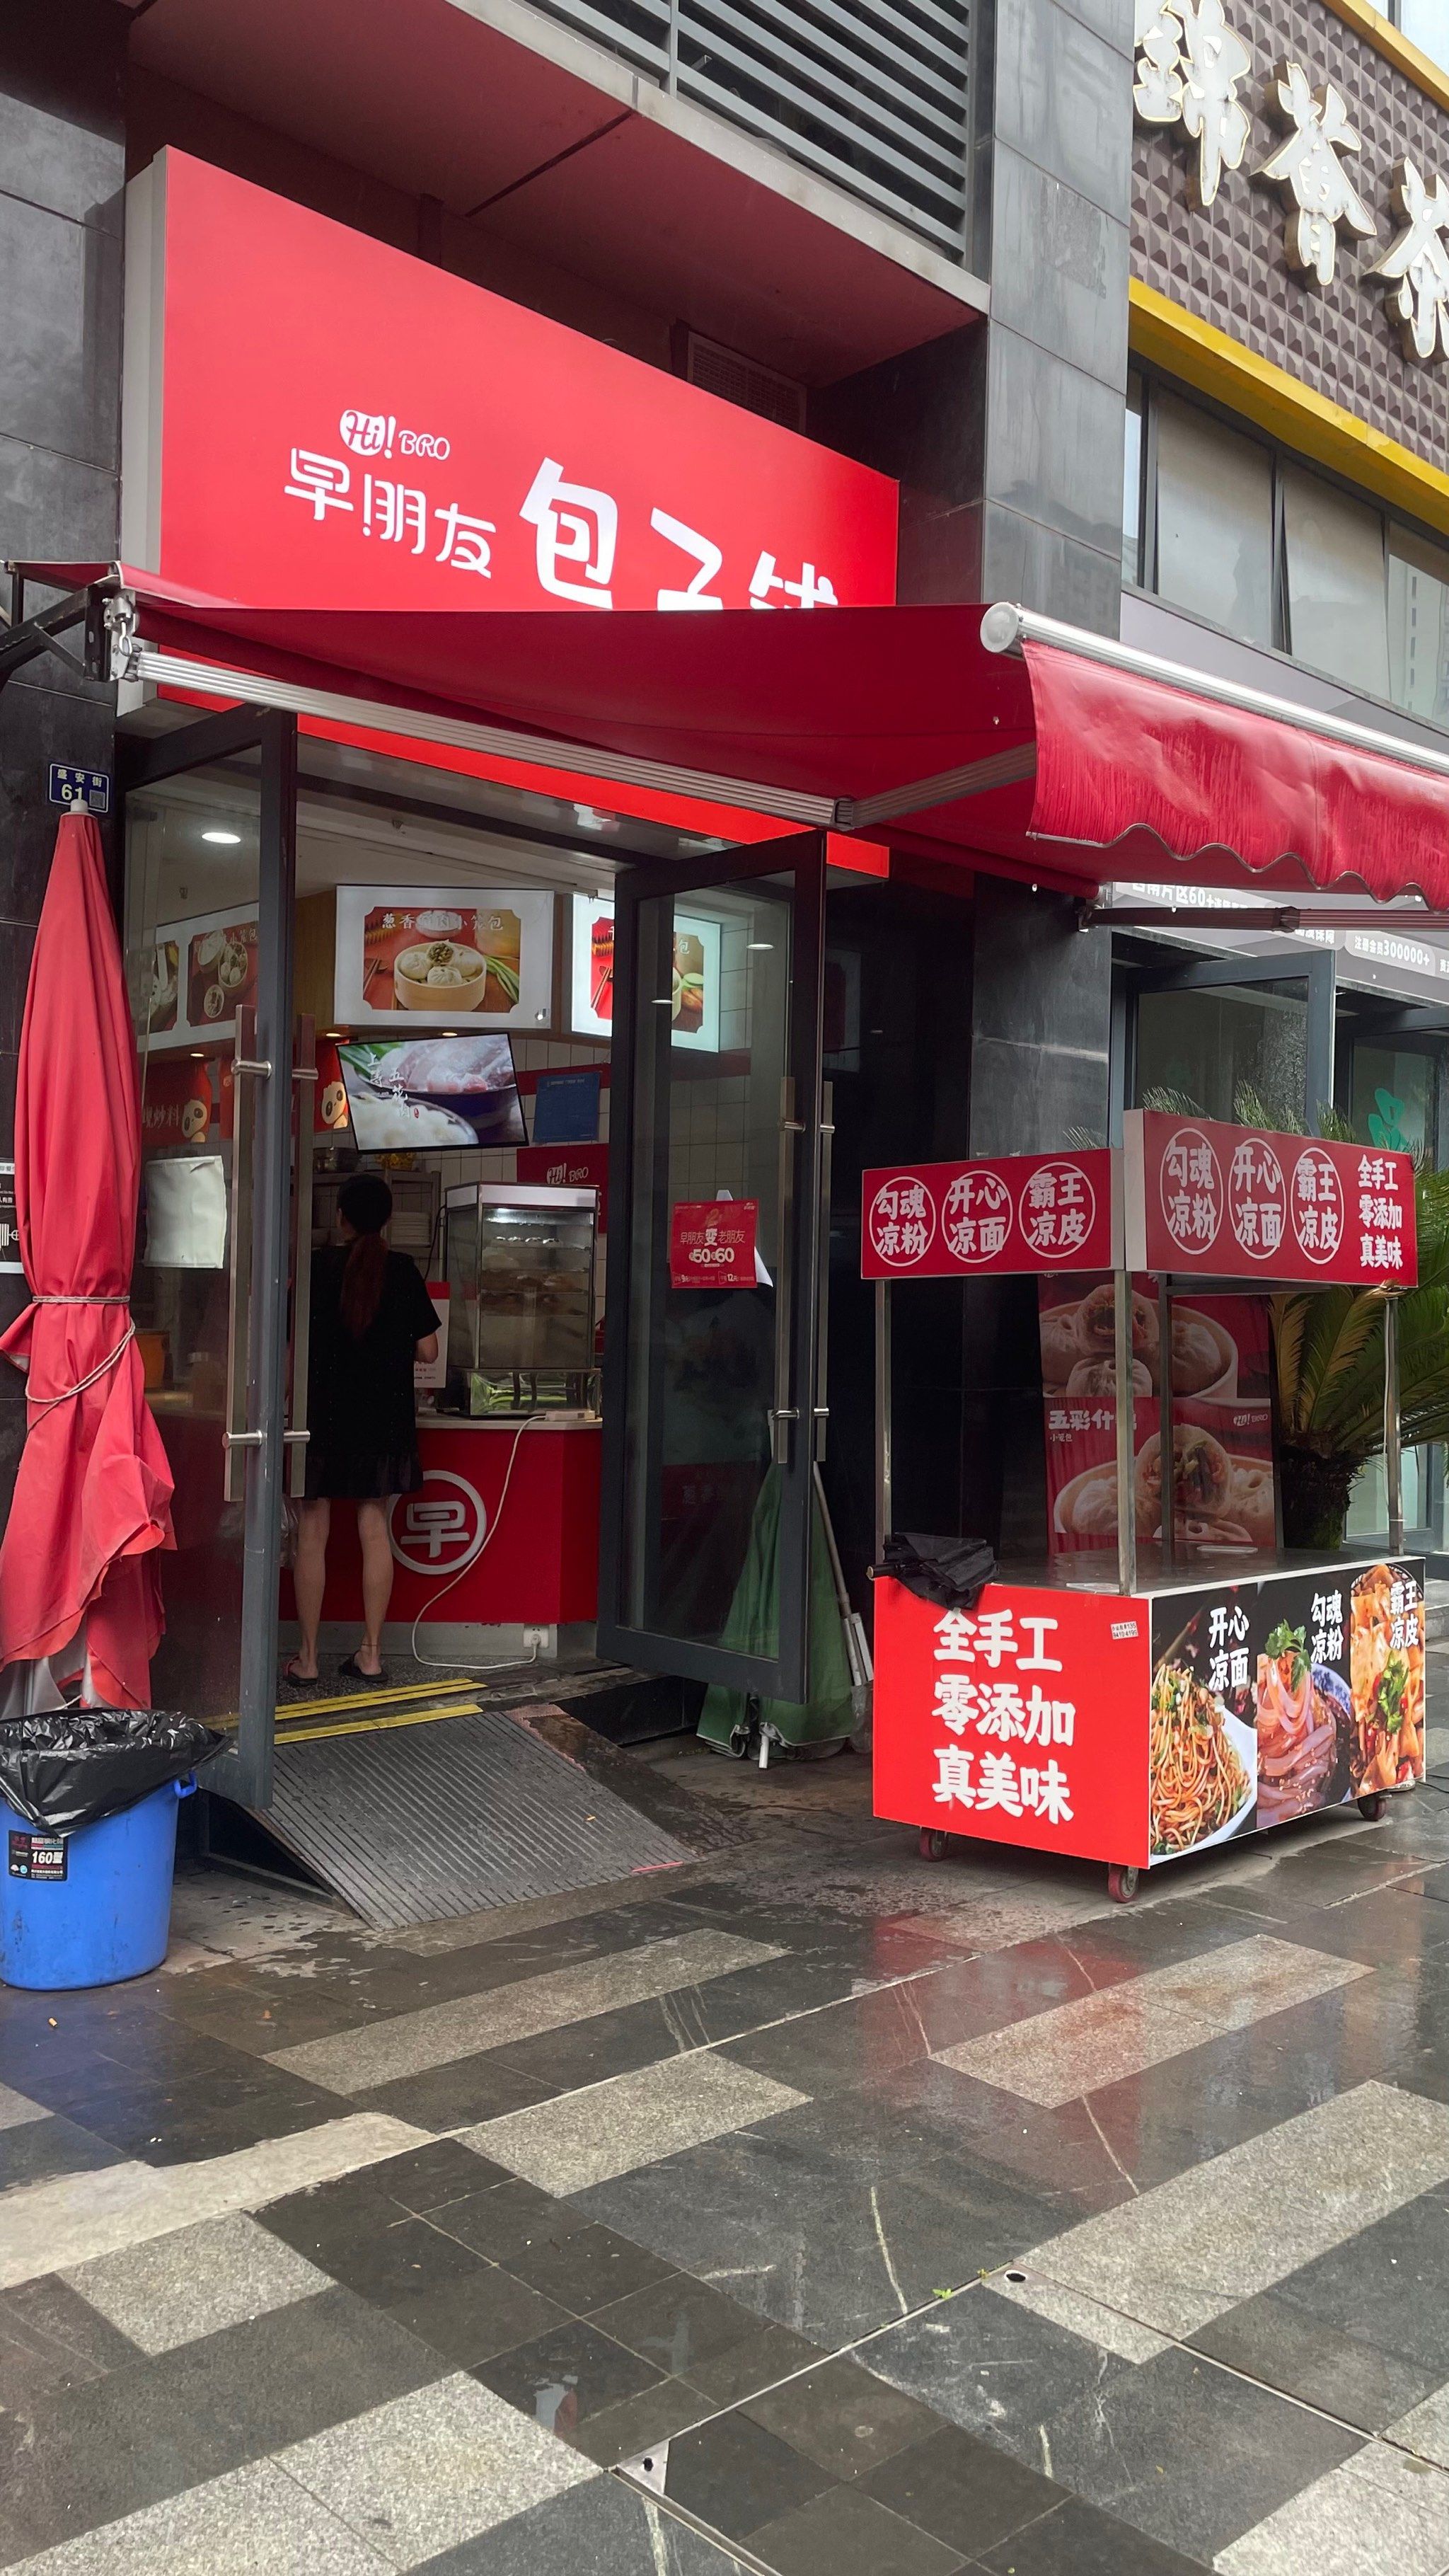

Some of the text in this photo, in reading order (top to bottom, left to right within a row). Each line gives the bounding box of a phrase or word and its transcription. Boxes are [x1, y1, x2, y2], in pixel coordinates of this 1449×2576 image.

[340, 410, 451, 461] Hi! BRO
[284, 447, 497, 579] 早朋友
[62, 783, 83, 801] 61
[569, 1166, 589, 1183] BRO
[1165, 1142, 1216, 1190] 勾魂
[1234, 1145, 1281, 1193] 开心
[1297, 1163, 1337, 1202] 霸王
[1358, 1154, 1398, 1192] 全手工
[876, 1186, 926, 1217] 勾魂
[949, 1178, 1008, 1215] 开心
[1029, 1171, 1085, 1210] 霸王
[1029, 1209, 1087, 1247] 凉皮
[1167, 1190, 1216, 1241] 凉粉
[1235, 1202, 1283, 1248] 凉面
[1298, 1207, 1339, 1251] 凉皮
[1358, 1194, 1403, 1229] 零添加
[877, 1225, 928, 1256] 凉粉
[949, 1217, 1007, 1255] 凉面
[1359, 1234, 1403, 1271] 真美味
[400, 1501, 471, 1558] 早
[1311, 1589, 1344, 1626] 勾魂
[1390, 1579, 1418, 1614] 霸王
[934, 1608, 1063, 1673] 全手工
[1208, 1605, 1249, 1649] 开心
[1310, 1628, 1344, 1664] 凉粉
[1390, 1614, 1420, 1650] 凉皮
[1208, 1646, 1249, 1692] 凉面
[931, 1674, 1075, 1747] 零添加
[932, 1744, 1075, 1824] 真美味
